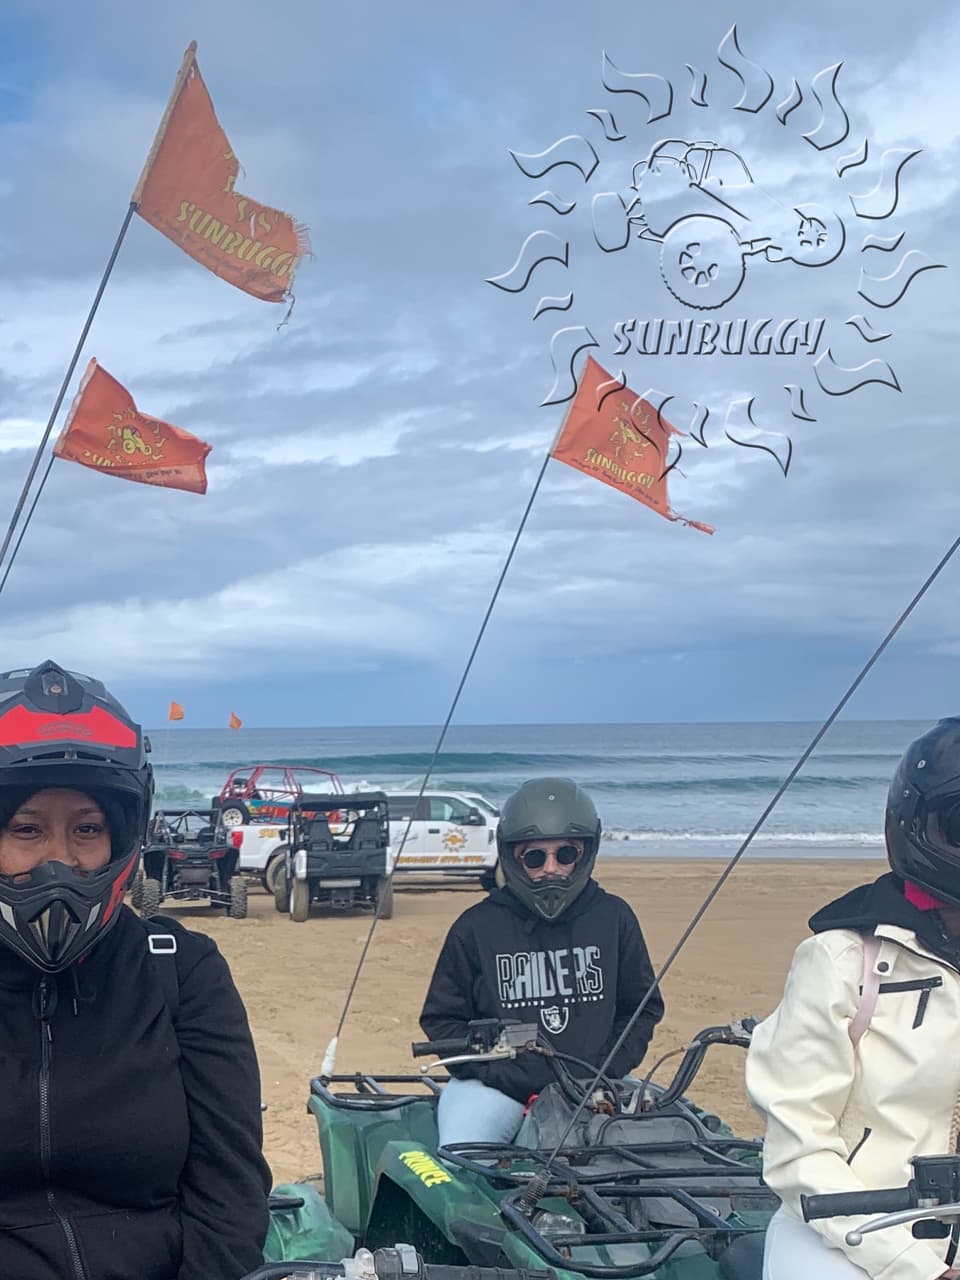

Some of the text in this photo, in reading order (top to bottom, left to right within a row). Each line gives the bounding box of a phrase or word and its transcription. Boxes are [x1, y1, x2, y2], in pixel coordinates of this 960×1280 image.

[176, 201, 297, 277] SUNBUGG
[583, 448, 655, 488] SUNBUGGY
[495, 945, 604, 1001] RAIDERS
